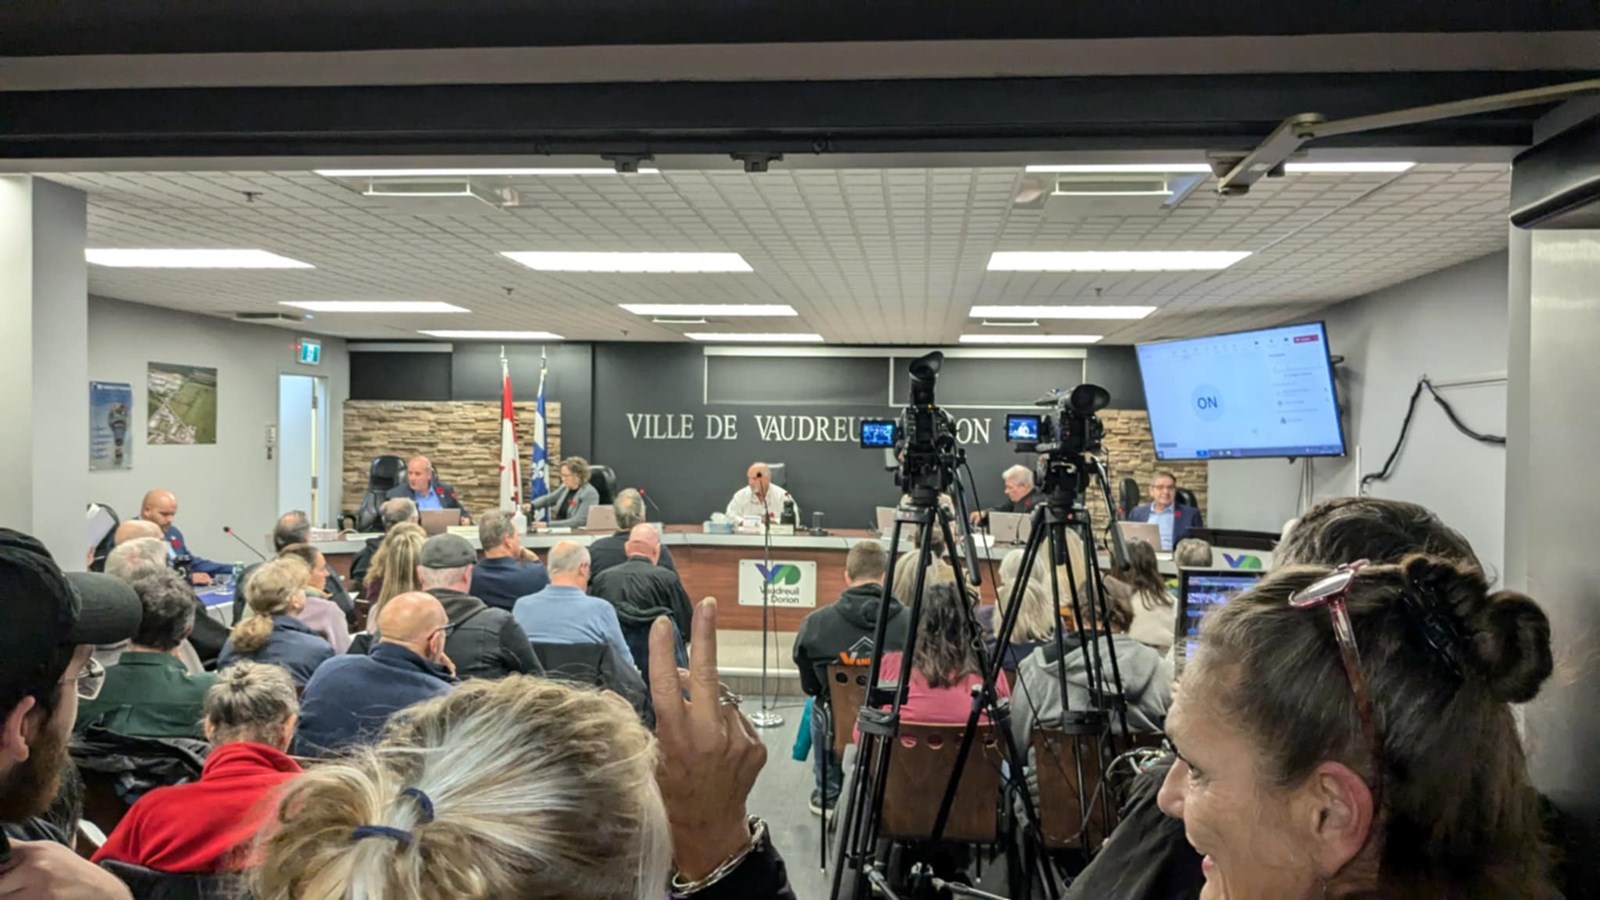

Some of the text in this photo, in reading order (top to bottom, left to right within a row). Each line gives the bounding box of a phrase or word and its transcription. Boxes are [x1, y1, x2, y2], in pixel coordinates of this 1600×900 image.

[1197, 396, 1218, 410] ON
[627, 413, 694, 440] VILLE
[706, 414, 737, 440] DE
